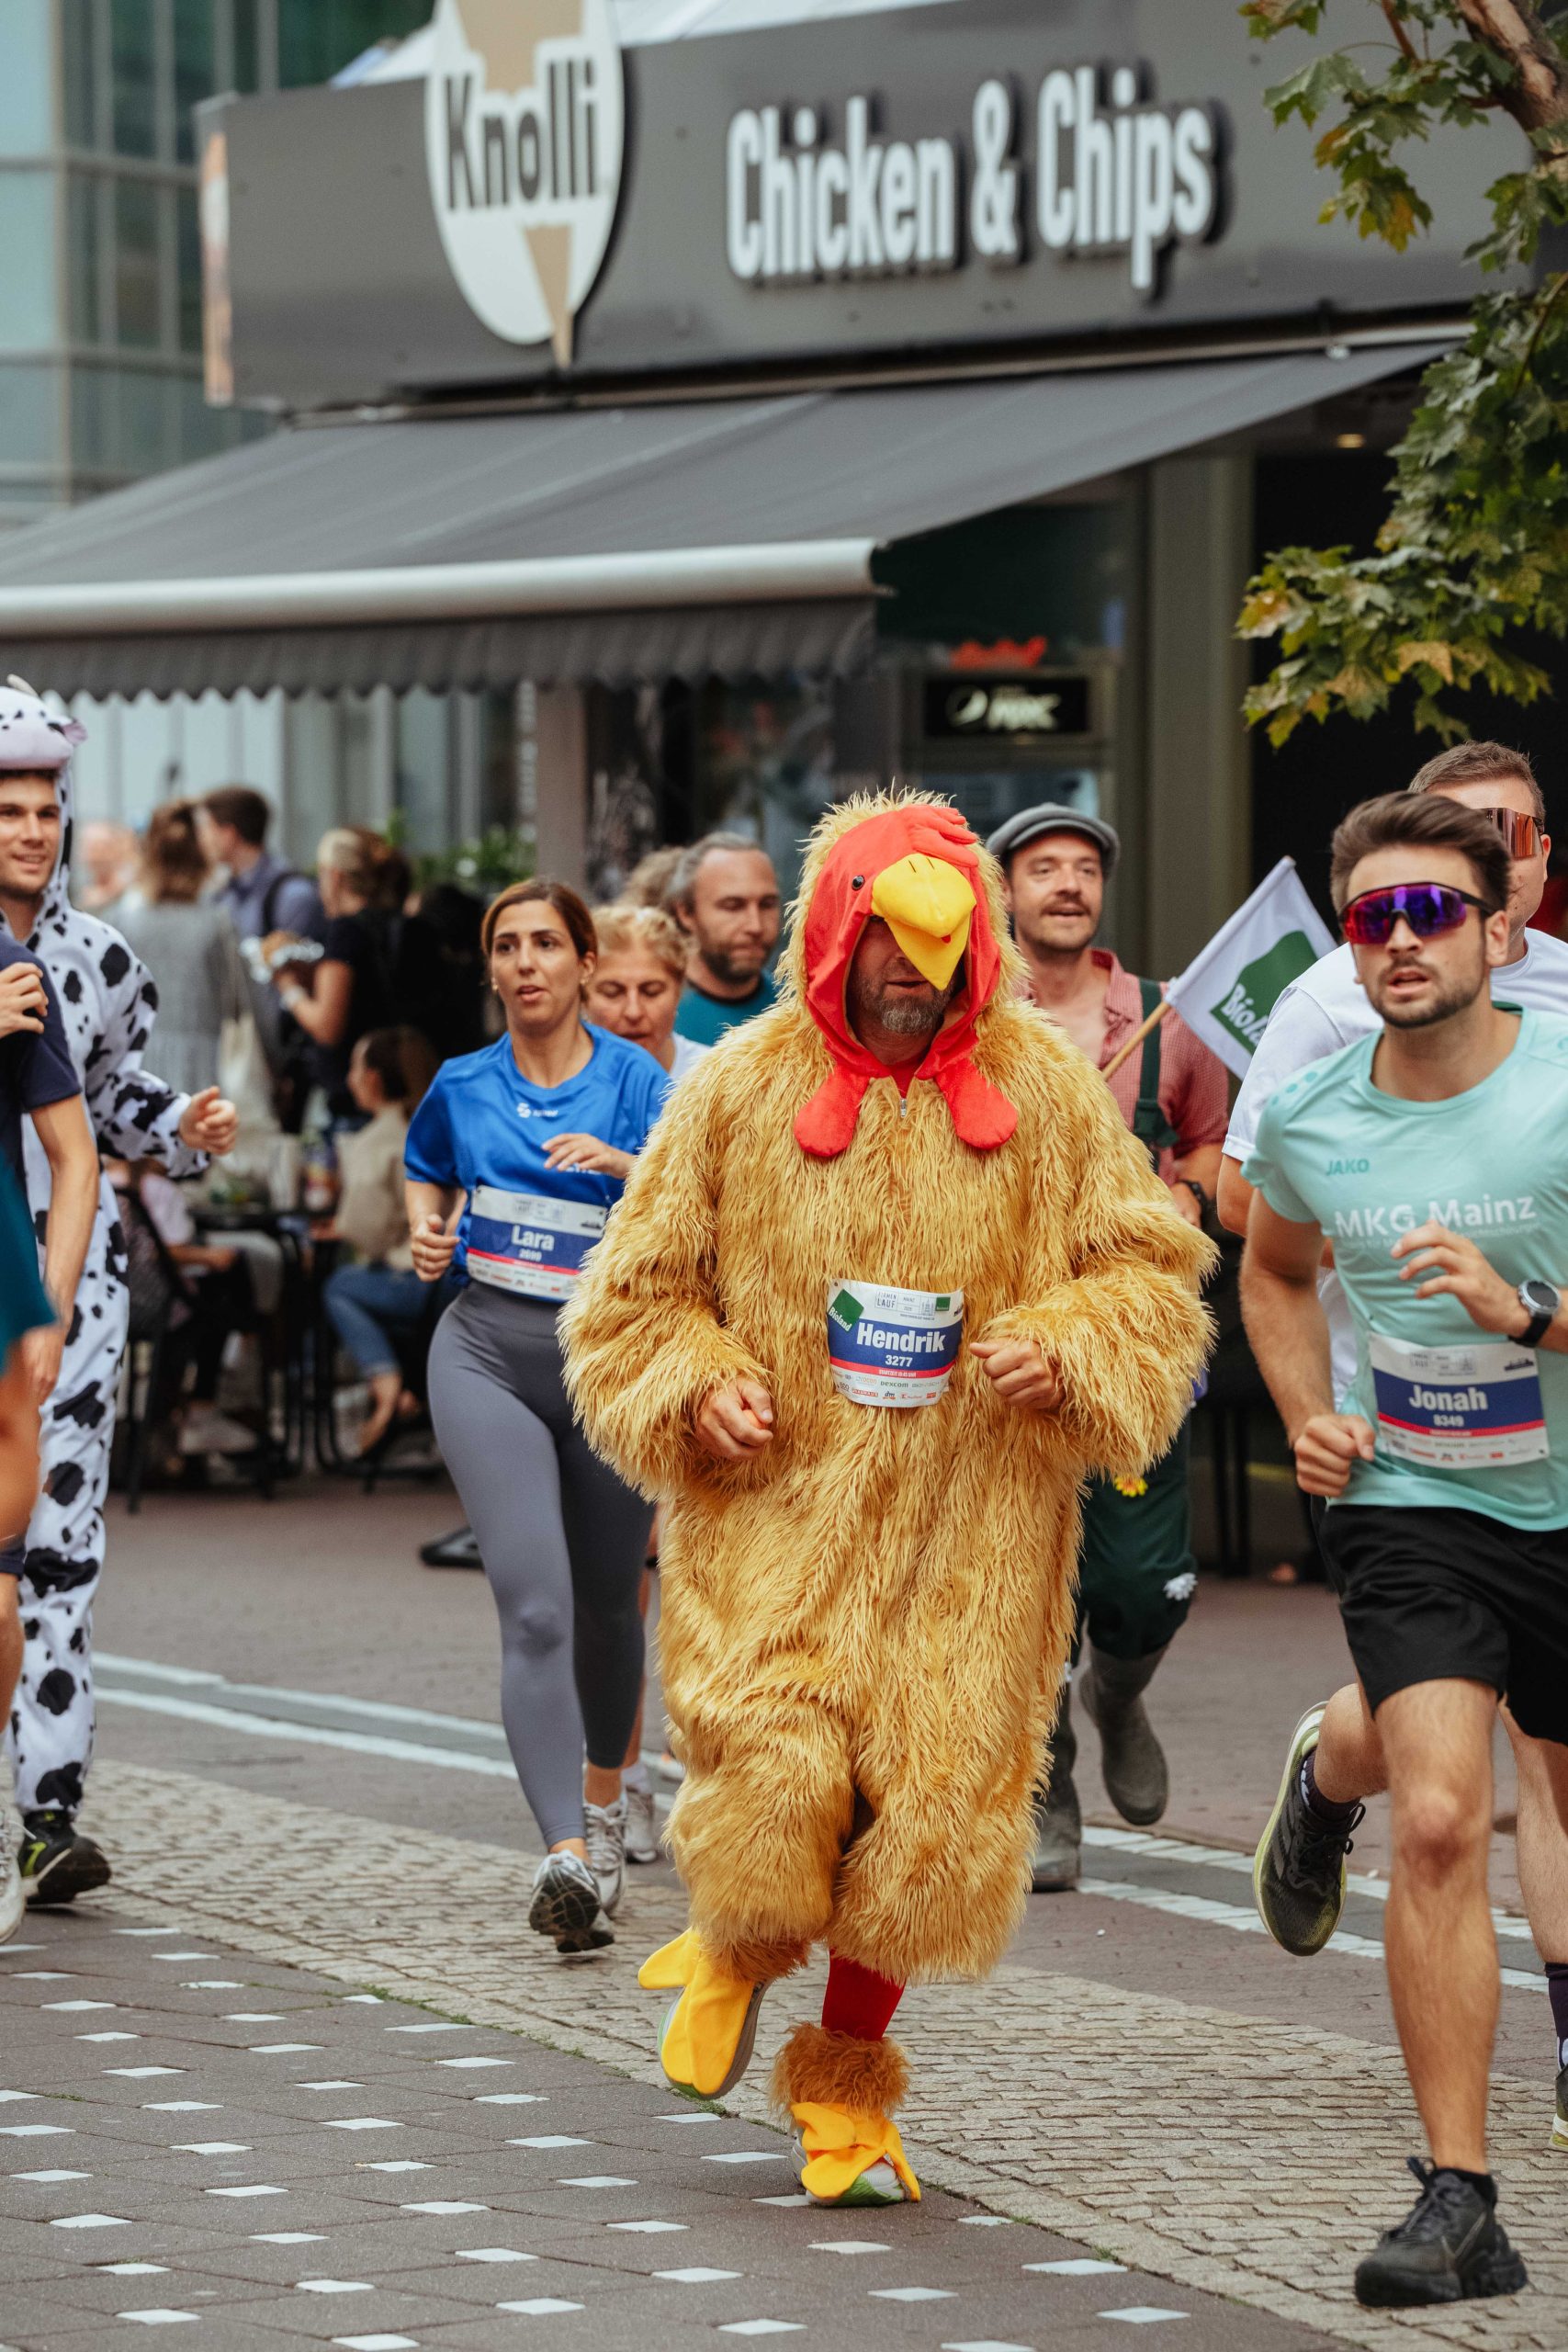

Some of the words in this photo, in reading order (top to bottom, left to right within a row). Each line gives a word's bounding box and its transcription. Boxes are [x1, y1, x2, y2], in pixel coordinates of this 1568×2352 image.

[443, 57, 603, 211] Knolli
[728, 96, 956, 280] Chicken
[971, 79, 1020, 256] &
[1039, 67, 1214, 290] Chips
[1325, 1159, 1370, 1176] JAKO
[1334, 1204, 1416, 1239] MKG
[1427, 1193, 1537, 1228] Mainz
[511, 1225, 555, 1251] Lara
[876, 1297, 896, 1308] LAUF
[828, 1306, 852, 1332] Bioland
[857, 1322, 946, 1353] Hendrik
[885, 1355, 913, 1367] 3277
[1408, 1384, 1489, 1412] Jonah
